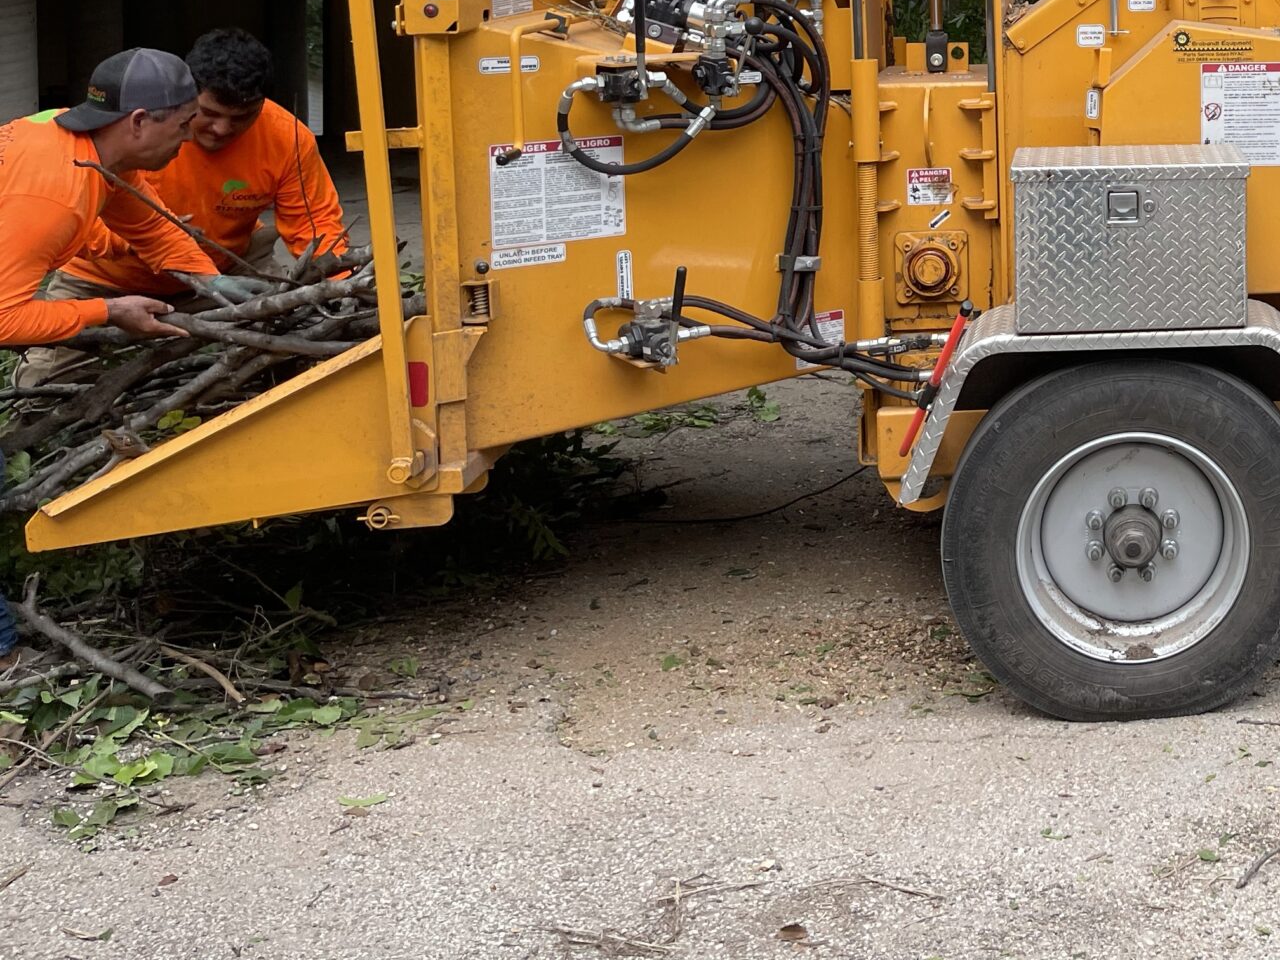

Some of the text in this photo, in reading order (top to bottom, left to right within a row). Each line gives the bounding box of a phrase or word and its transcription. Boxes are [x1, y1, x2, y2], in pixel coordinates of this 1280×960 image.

[1228, 64, 1267, 72] DANGER
[506, 144, 547, 153] DNGER
[500, 246, 558, 259] UNLATCH BEFORE
[494, 258, 523, 267] CLOSING
[524, 255, 546, 263] INFEED
